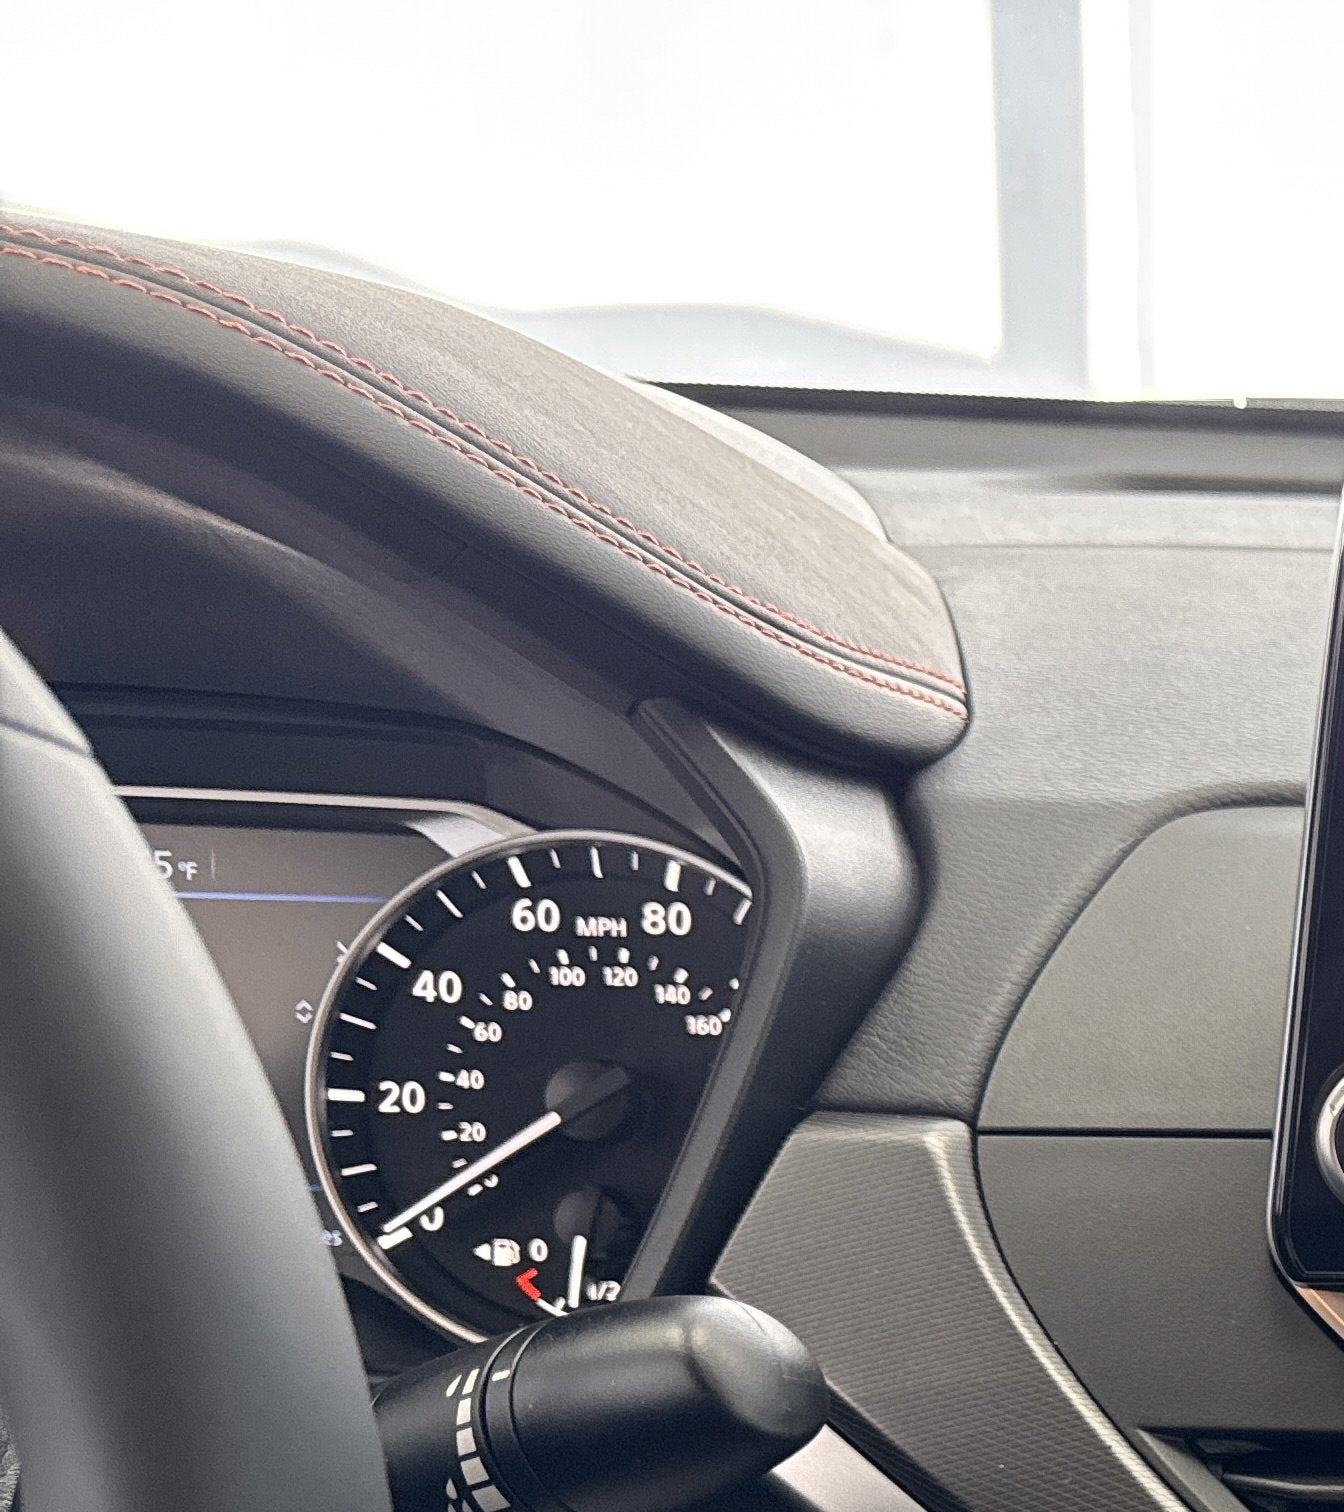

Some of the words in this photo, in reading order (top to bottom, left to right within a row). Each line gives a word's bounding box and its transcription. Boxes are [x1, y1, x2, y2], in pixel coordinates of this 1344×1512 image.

[511, 899, 560, 932] 60
[641, 902, 691, 935] 80
[575, 916, 627, 937] MPH
[412, 970, 462, 1003] 40
[550, 967, 586, 986] 100
[603, 967, 638, 986] 120
[503, 990, 532, 1010] 80
[654, 983, 690, 1004] 140
[473, 1022, 502, 1042] 60
[685, 1015, 722, 1035] 160
[455, 1070, 484, 1090] 40
[378, 1081, 425, 1114] 20
[459, 1122, 486, 1142] 20
[528, 1238, 548, 1262] 0
